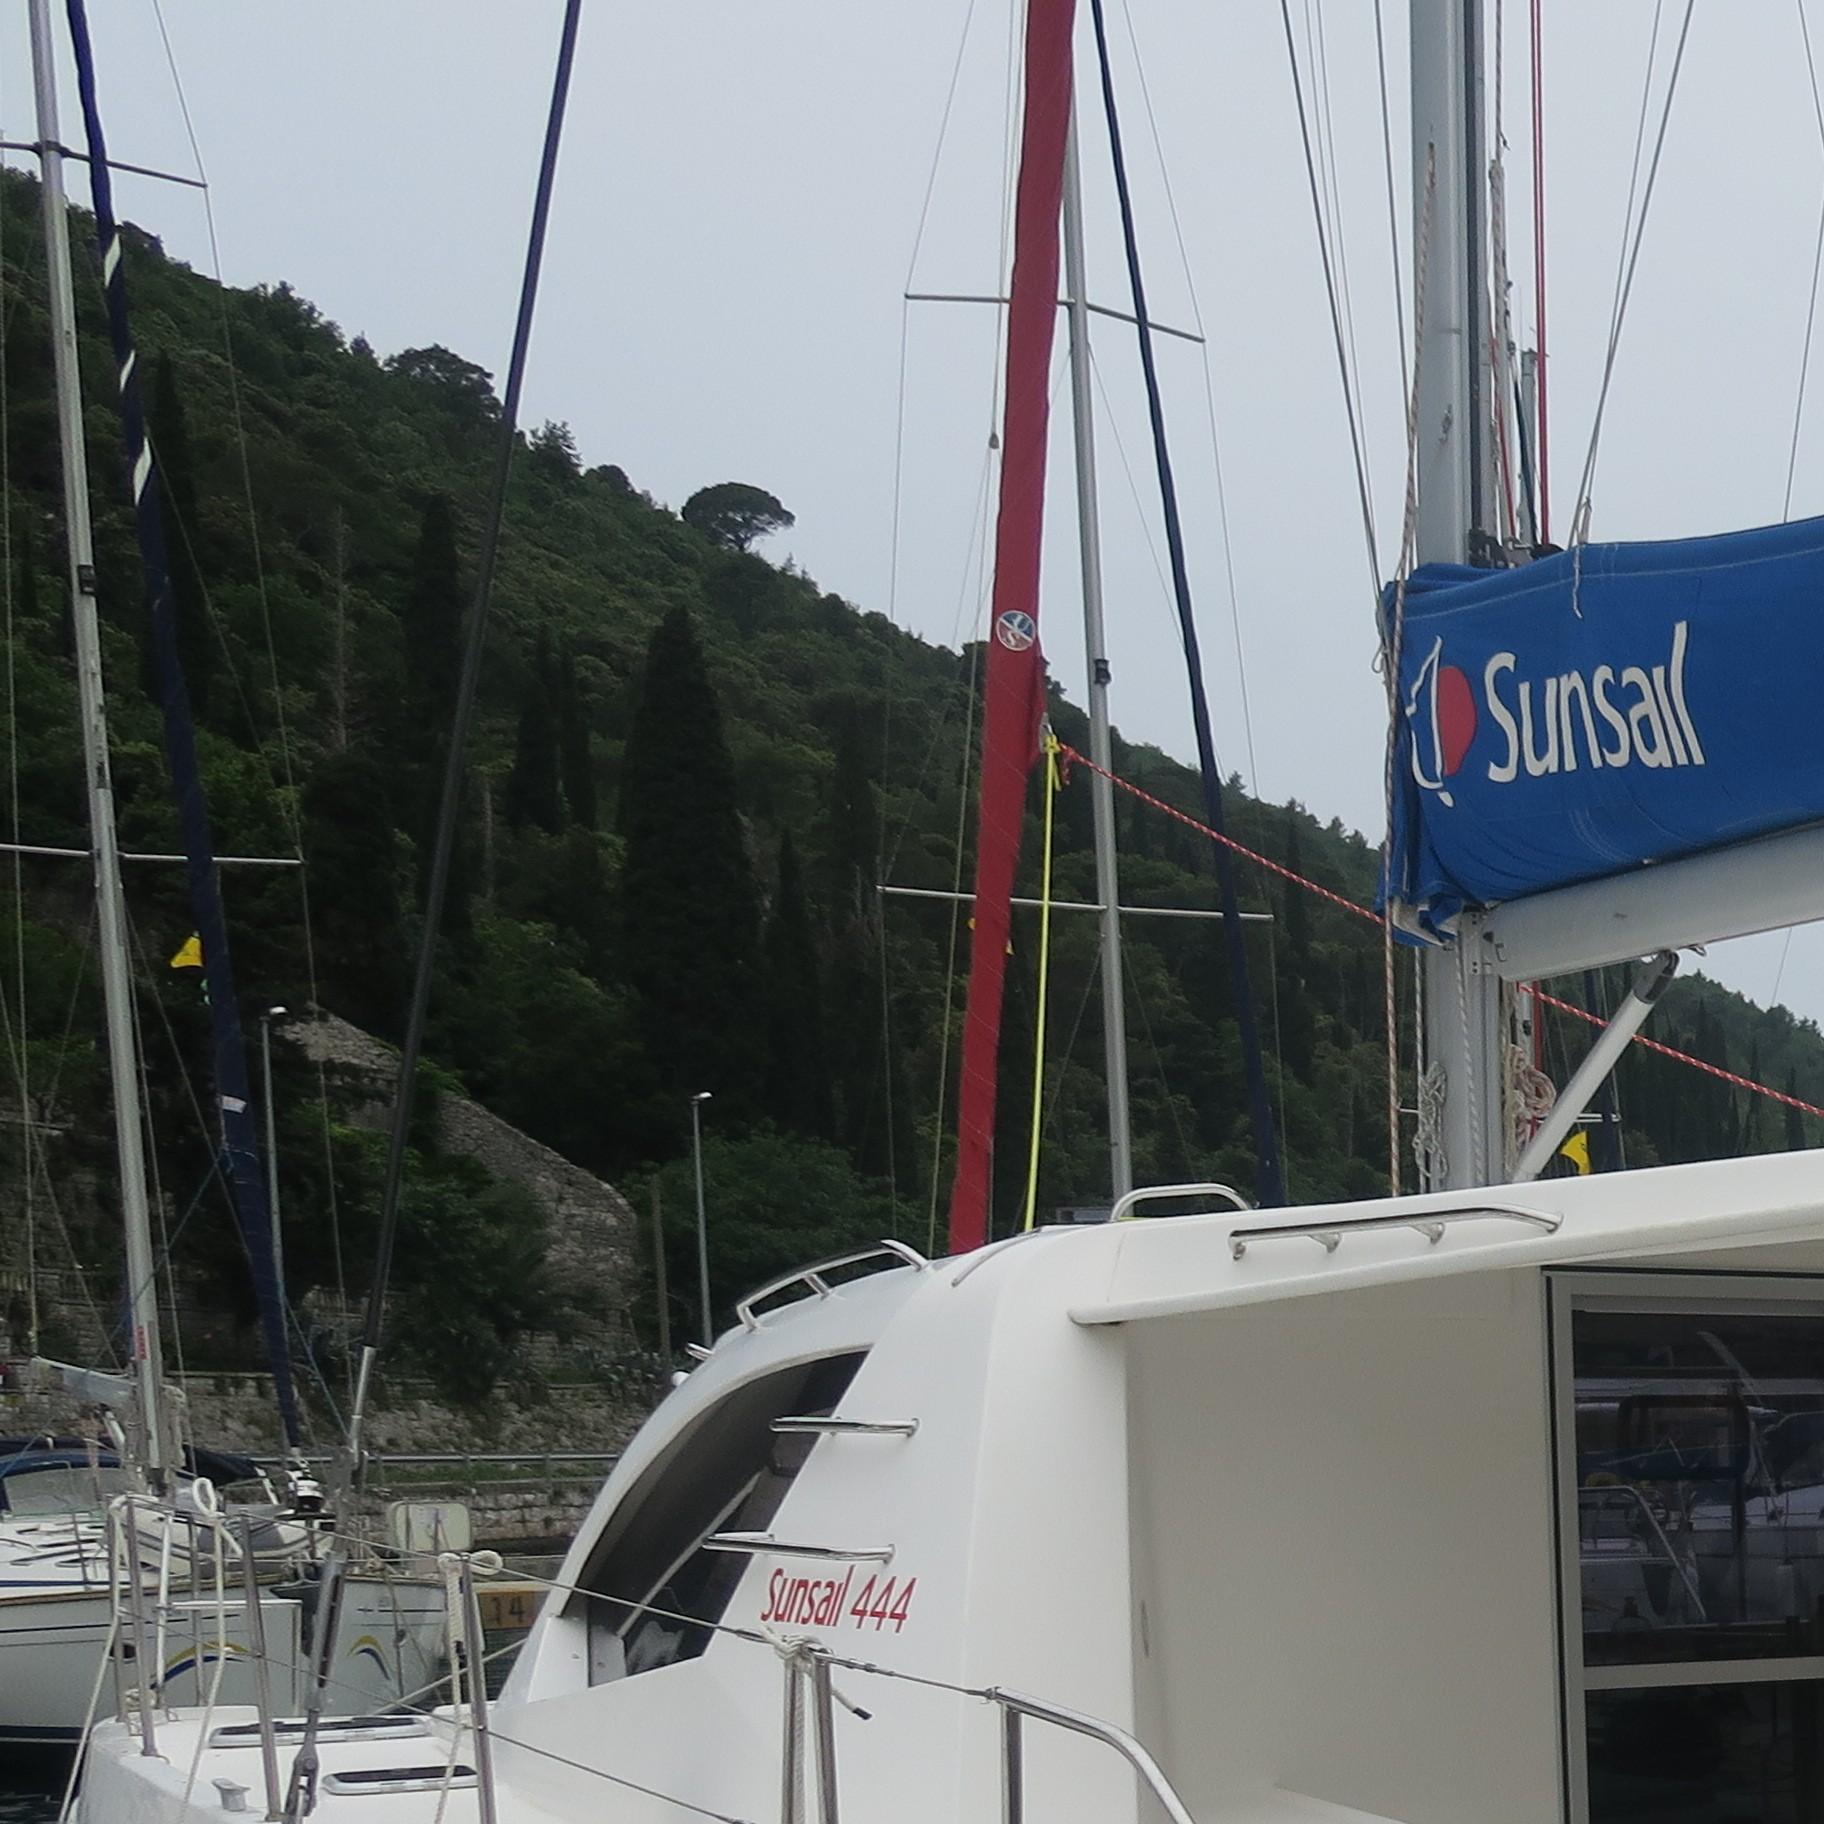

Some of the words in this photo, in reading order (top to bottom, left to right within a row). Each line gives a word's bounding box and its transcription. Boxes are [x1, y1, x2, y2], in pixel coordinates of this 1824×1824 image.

[1483, 620, 1706, 783] Sunsail
[760, 1564, 856, 1627] Sunsail
[850, 1574, 918, 1634] 444
